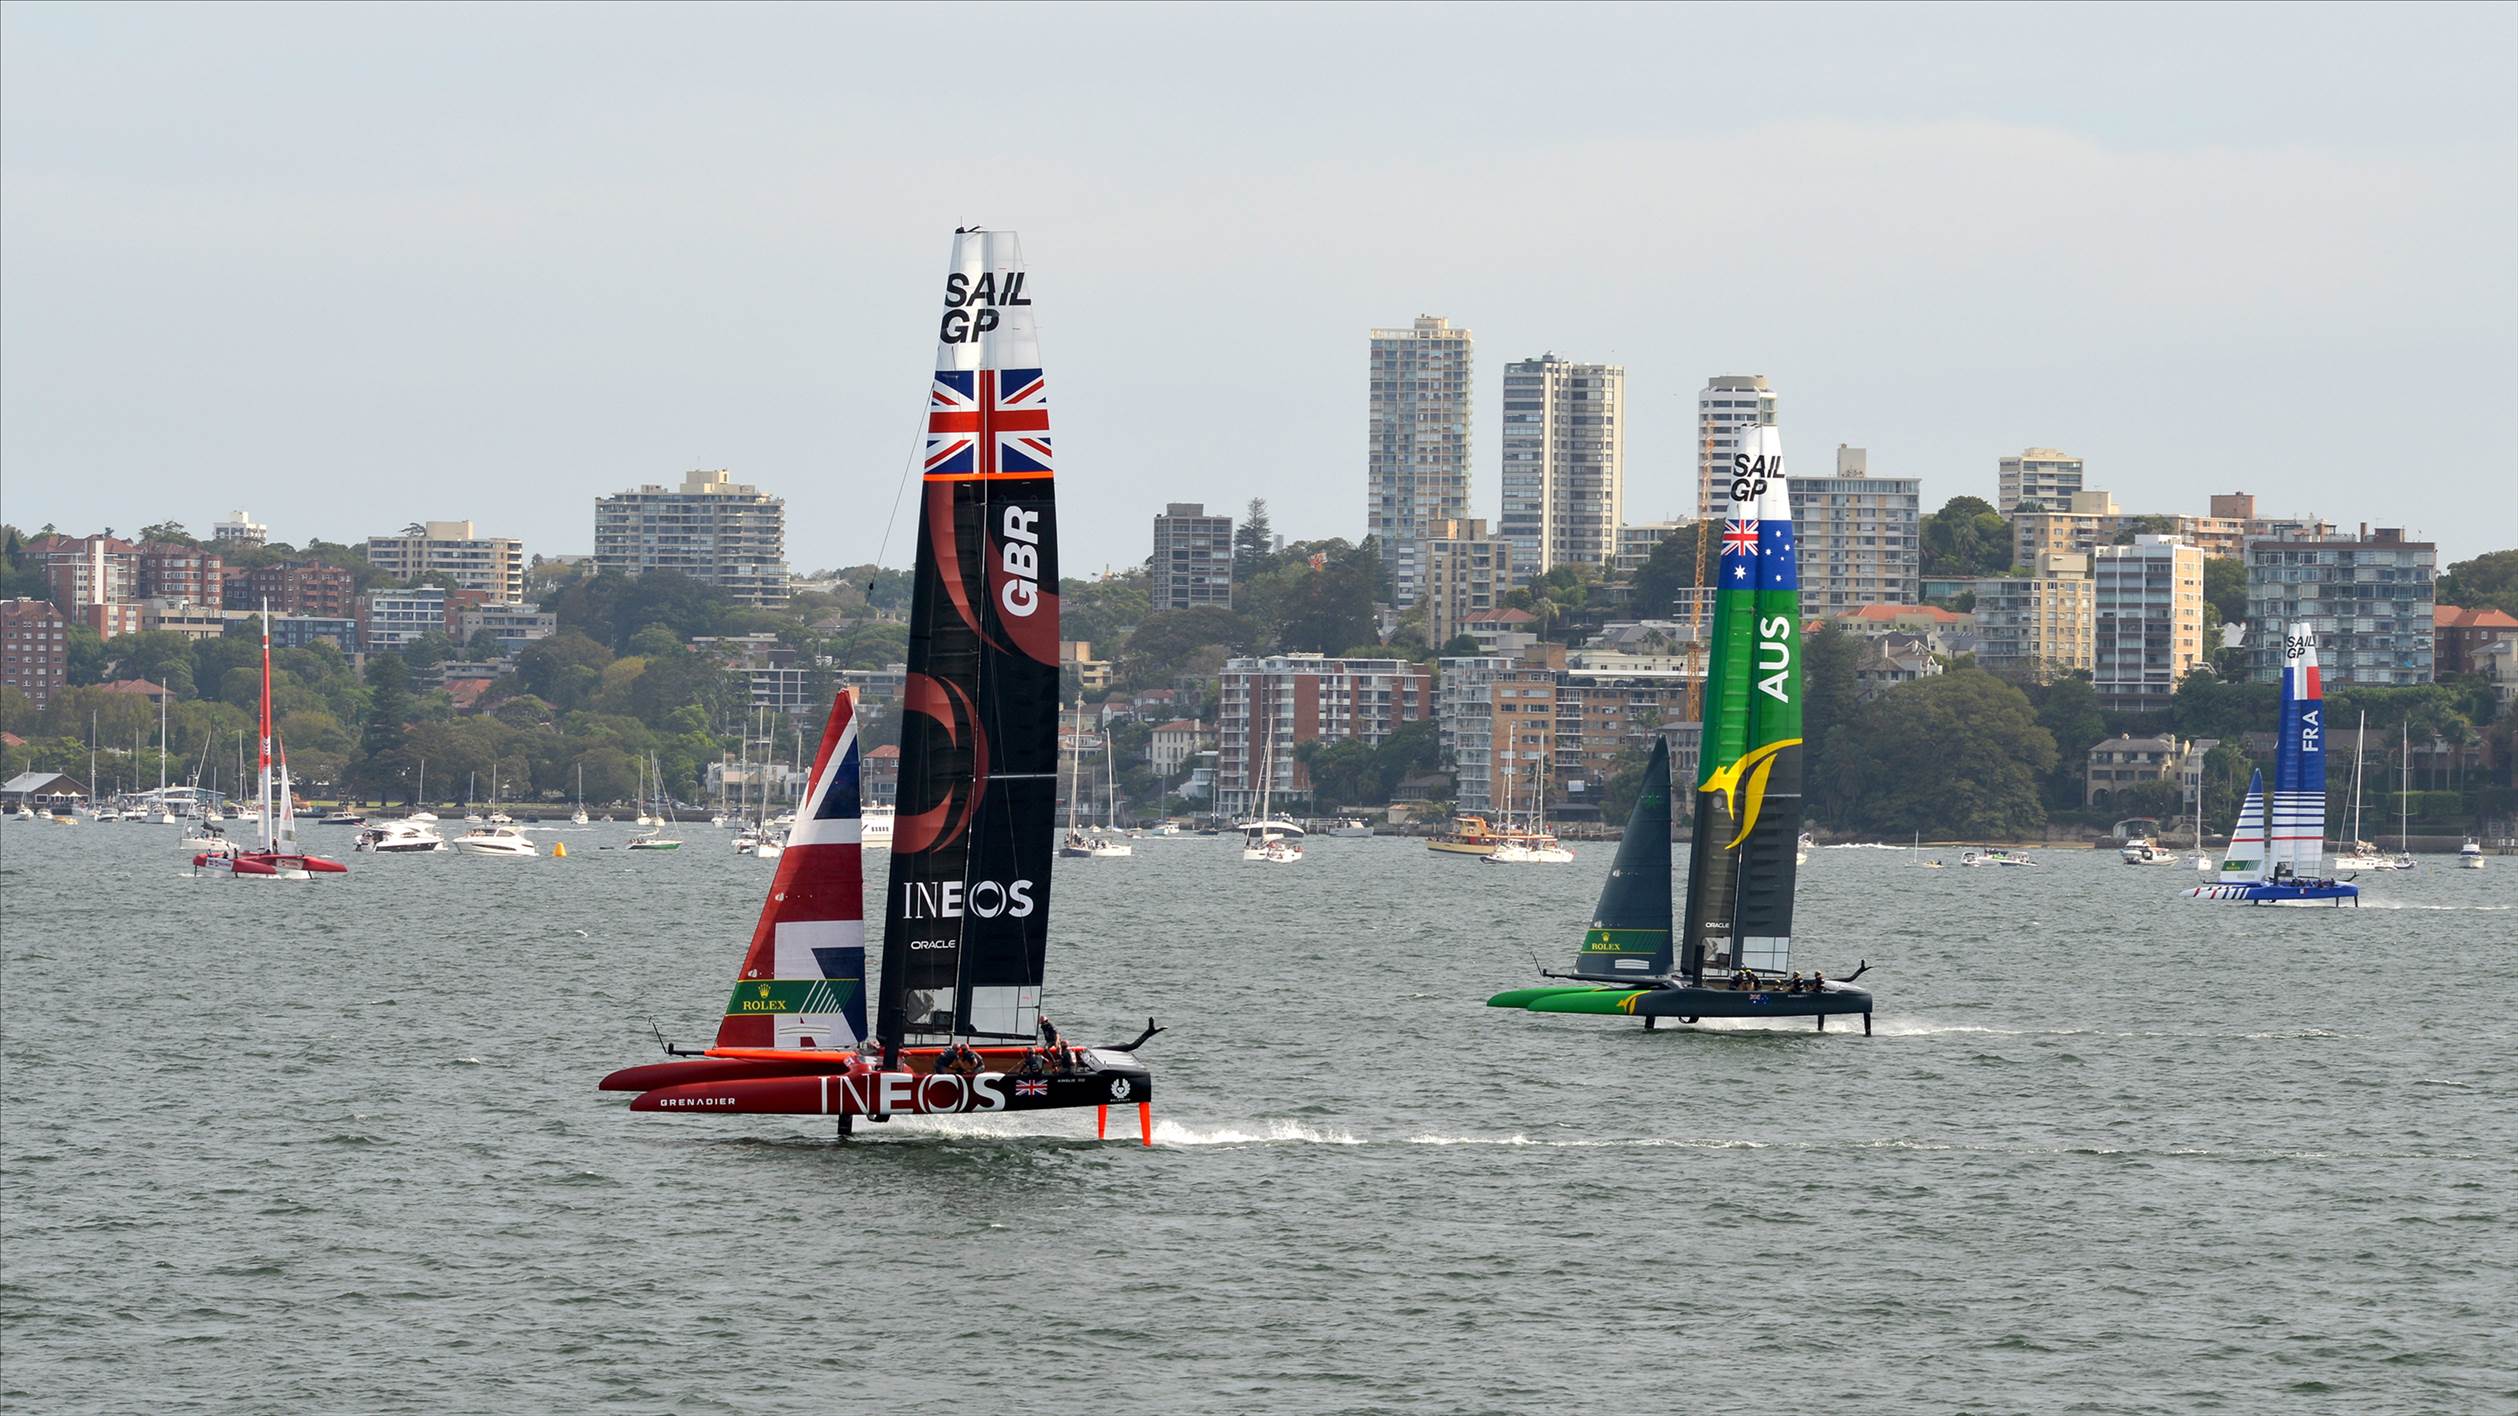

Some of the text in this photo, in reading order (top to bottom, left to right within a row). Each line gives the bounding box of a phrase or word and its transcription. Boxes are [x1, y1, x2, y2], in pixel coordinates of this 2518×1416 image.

[944, 272, 1032, 307] SAIL
[939, 308, 1000, 344] GP
[1732, 453, 1785, 479] SAIL
[1730, 478, 1768, 502] GP
[1002, 505, 1039, 617] GBR
[2286, 647, 2306, 659] GP
[2287, 636, 2316, 648] SAIL
[1758, 616, 1790, 704] AUS
[2302, 710, 2319, 752] FRA
[903, 879, 1034, 919] INEOS
[910, 939, 956, 950] ORACLE
[1591, 943, 1621, 951] ROLEX
[743, 1000, 787, 1011] ROLEX
[660, 1097, 736, 1107] GRENADIER
[816, 1072, 1006, 1115] INEOS
